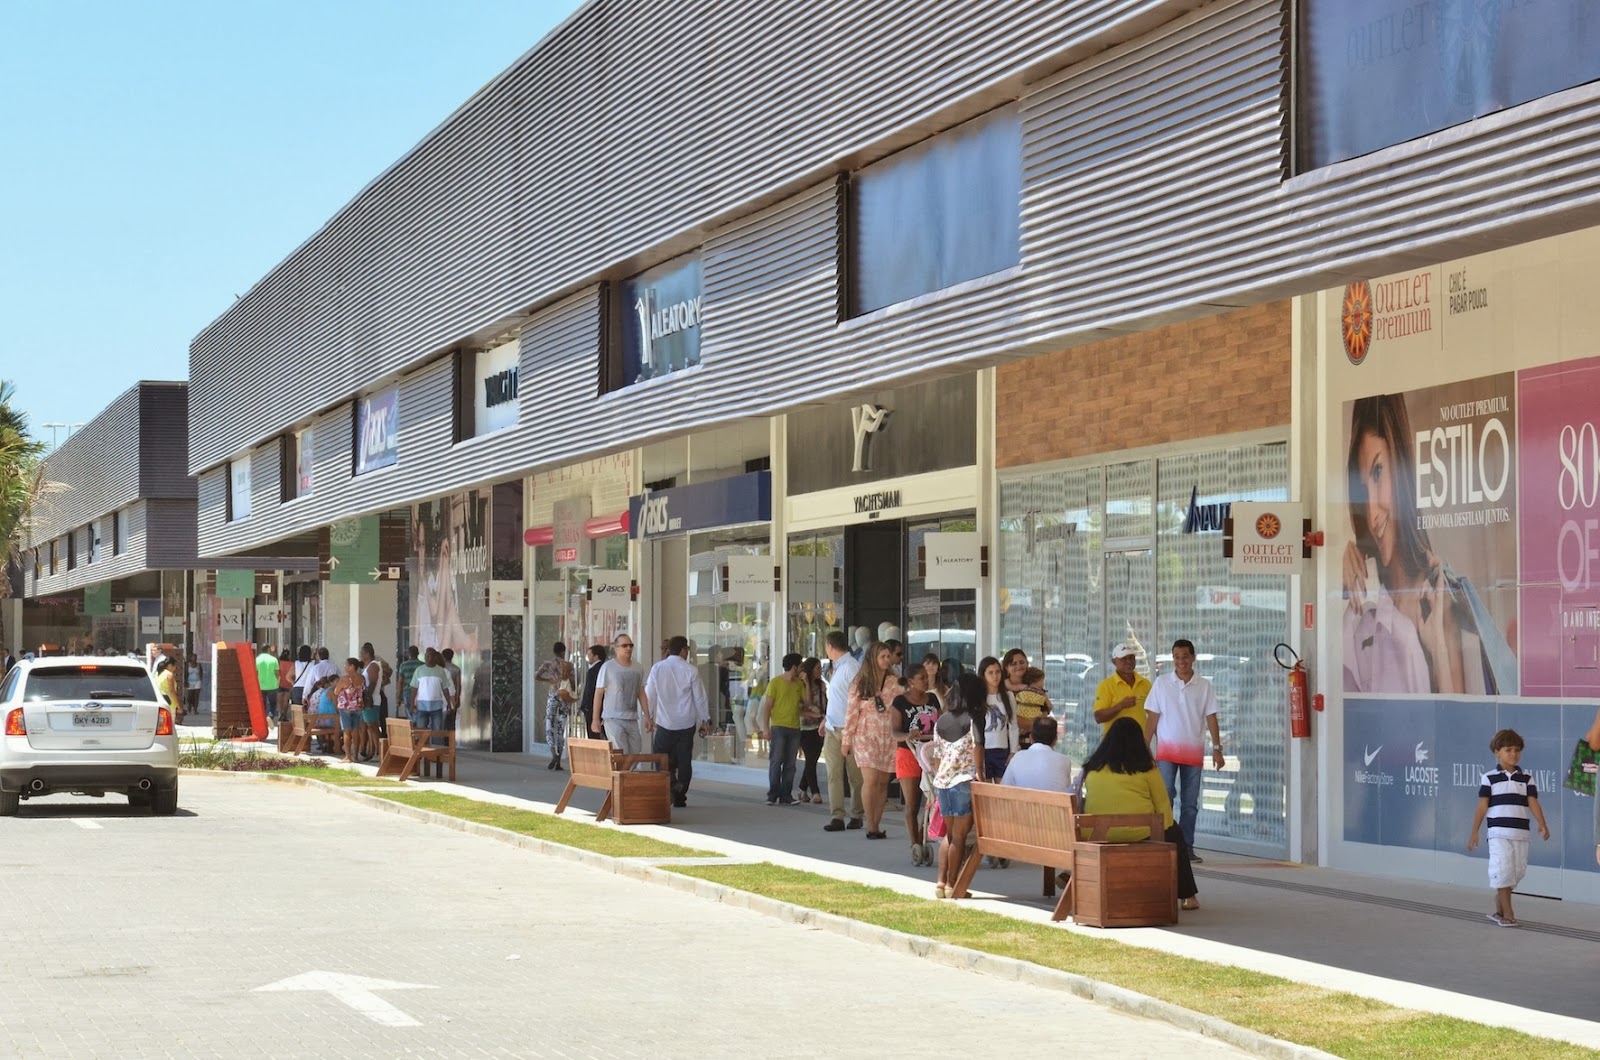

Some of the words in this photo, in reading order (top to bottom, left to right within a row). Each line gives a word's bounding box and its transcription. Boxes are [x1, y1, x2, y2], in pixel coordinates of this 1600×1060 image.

[1449, 294, 1468, 316] PAGAR
[651, 295, 700, 340] ALEATORY
[1440, 406, 1450, 421] NO
[1451, 401, 1475, 419] OUTLET
[1415, 418, 1509, 509] ESTILO
[853, 489, 900, 513] YACHTSMAN
[1417, 516, 1421, 530] E
[1422, 512, 1453, 529] ECONOMIA
[1454, 510, 1485, 527] DESFILAM
[223, 615, 238, 624] VR
[1570, 611, 1584, 627] ANO
[1405, 766, 1439, 784] LACOSTE
[1405, 785, 1439, 797] OUTLET
